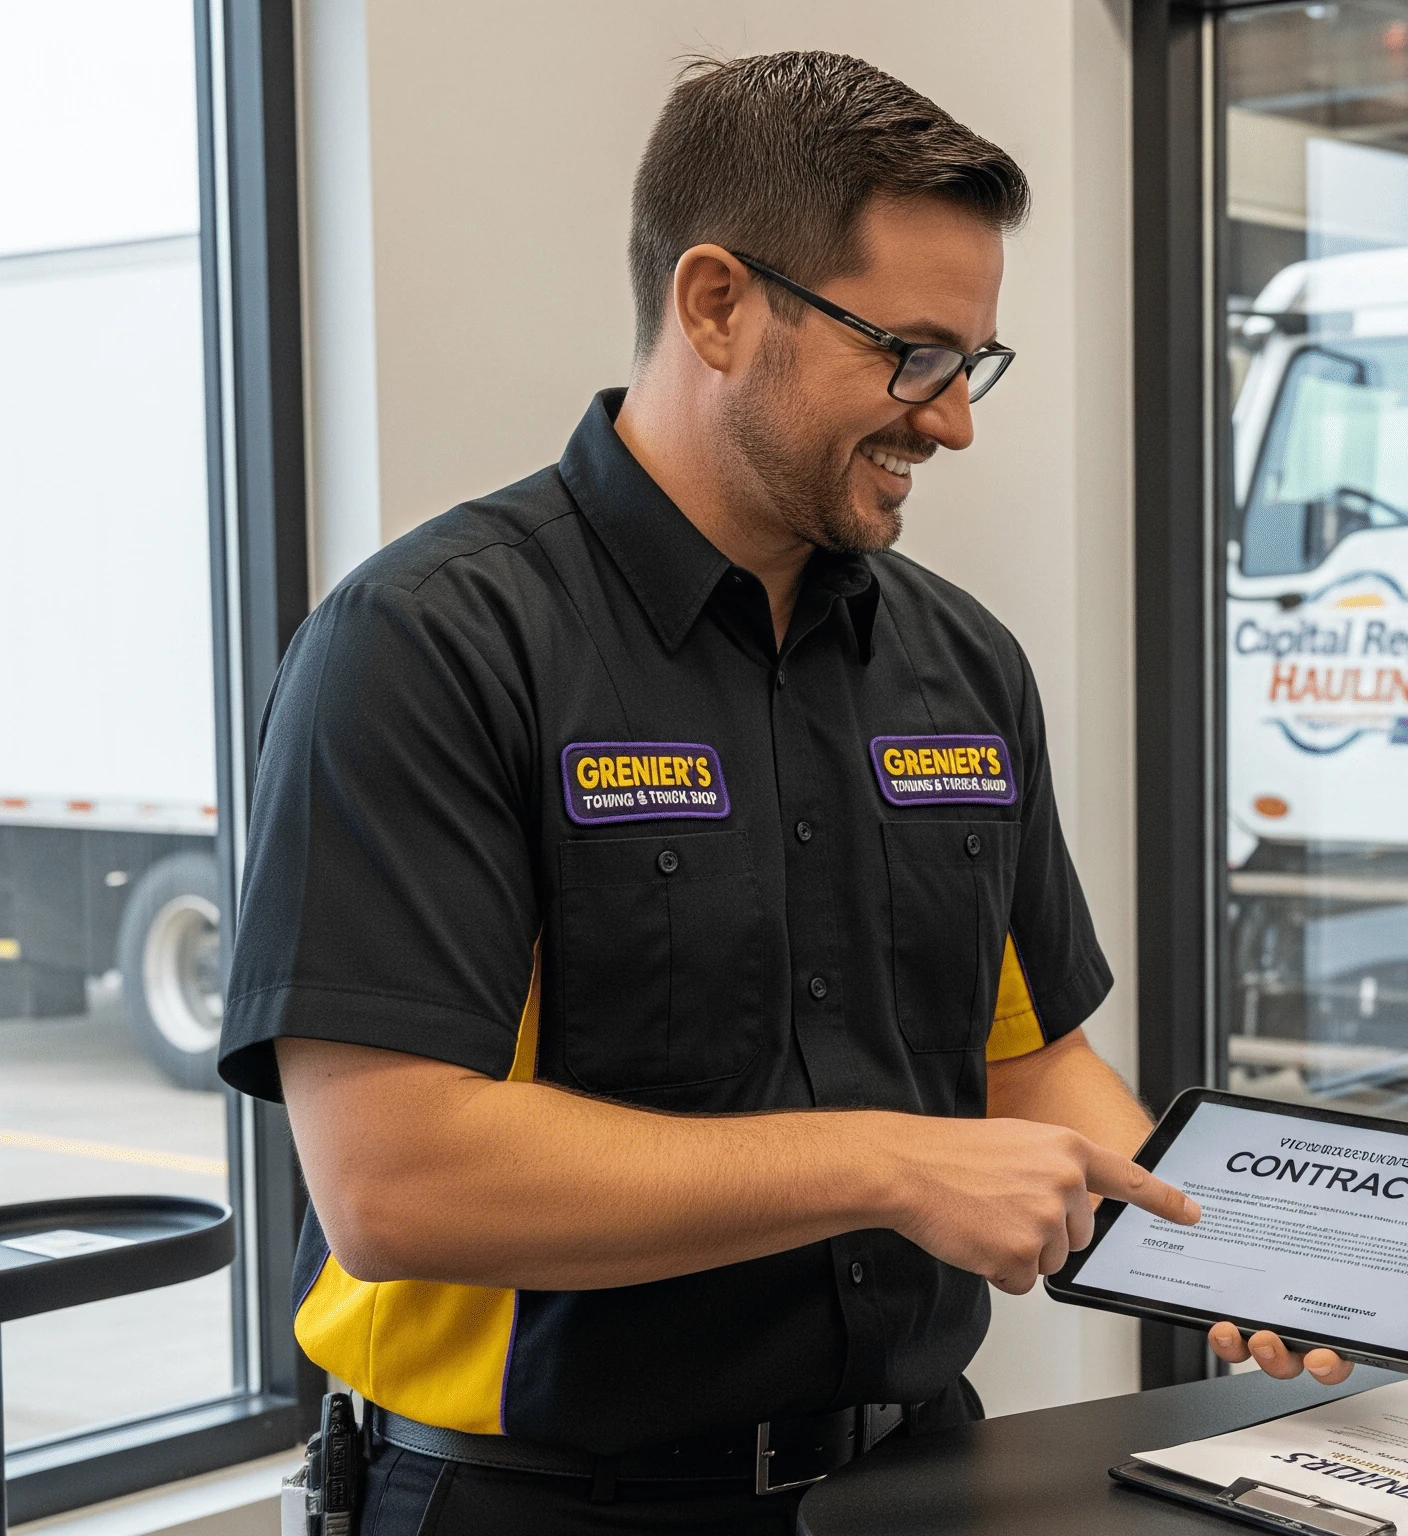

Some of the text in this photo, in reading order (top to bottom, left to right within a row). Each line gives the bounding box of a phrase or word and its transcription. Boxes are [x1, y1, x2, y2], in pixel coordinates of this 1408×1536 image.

[1235, 618, 1352, 659] Capital
[576, 756, 712, 789] GRENIER'S
[883, 747, 1001, 776] GRENIER'S
